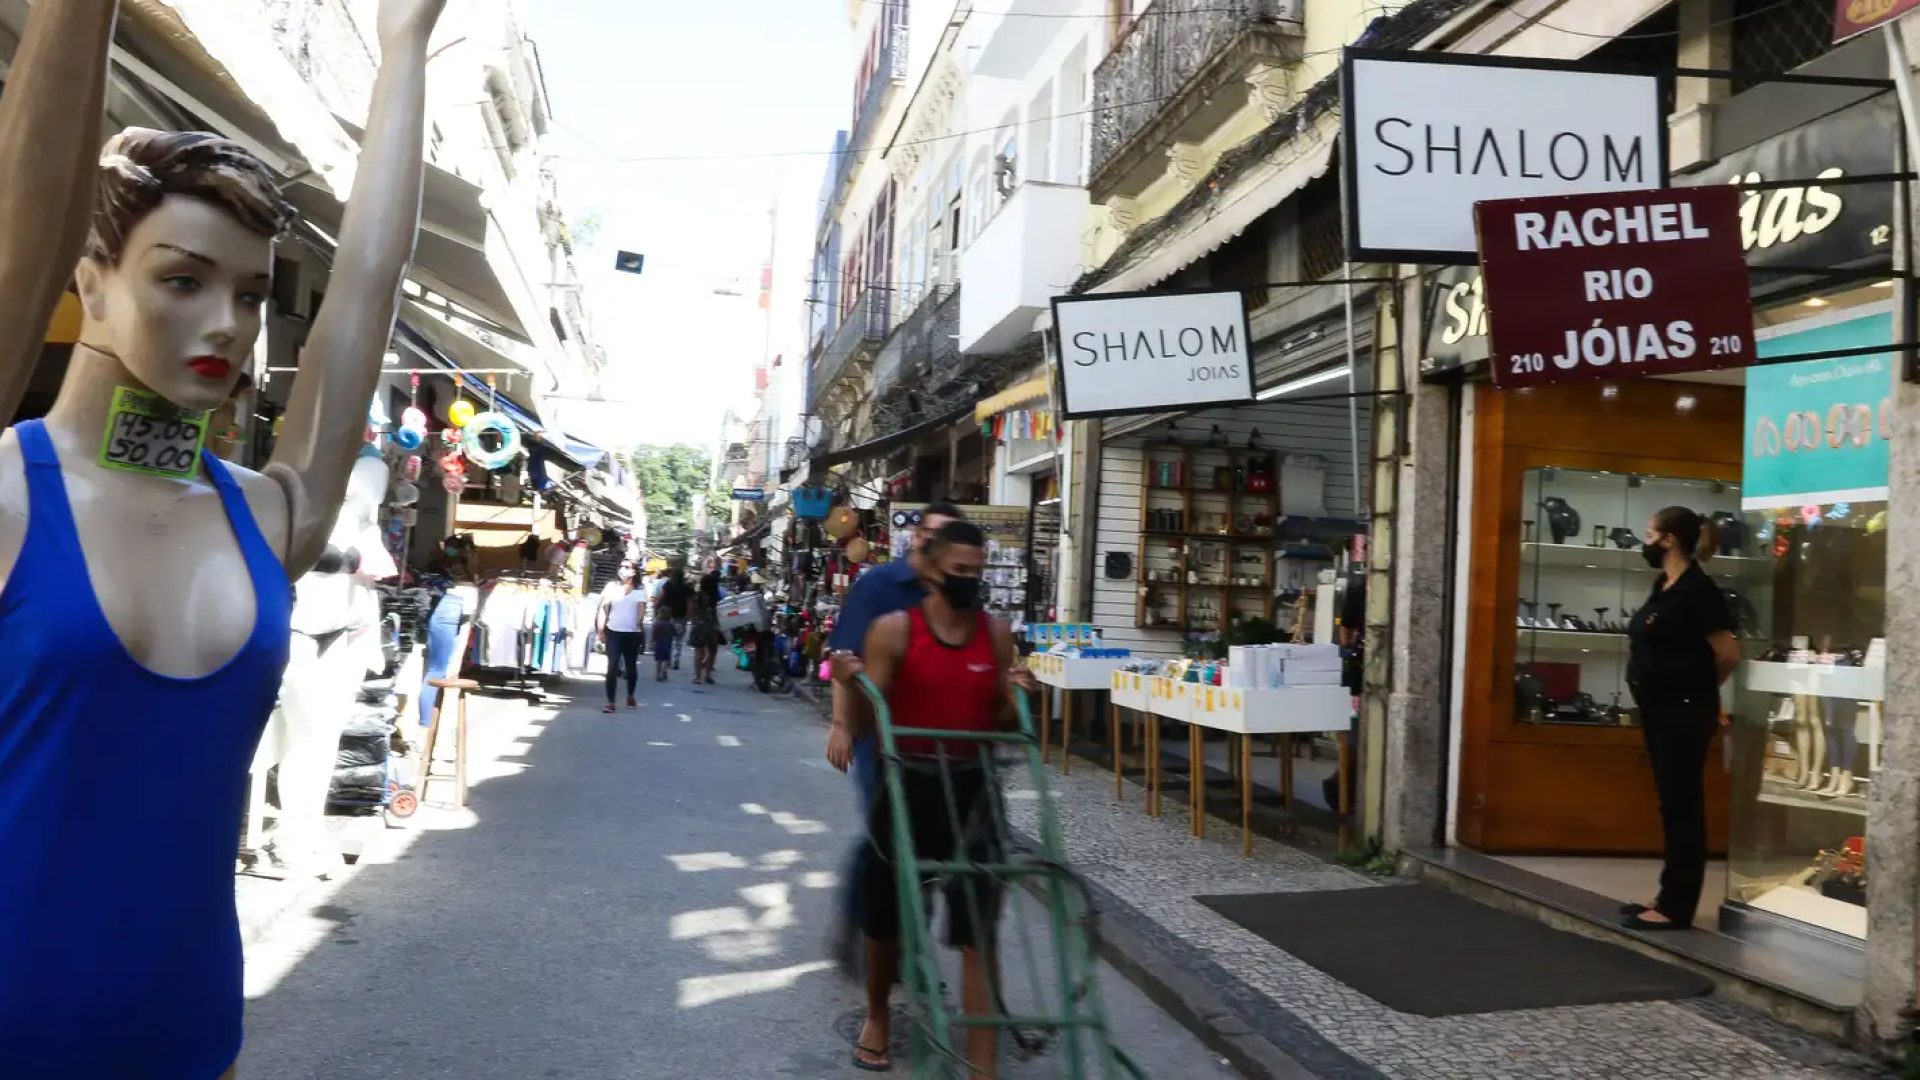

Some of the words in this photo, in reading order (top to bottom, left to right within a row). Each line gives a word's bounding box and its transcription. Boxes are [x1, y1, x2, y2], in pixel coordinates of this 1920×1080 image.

[1374, 117, 1643, 183] SHALOM
[1514, 203, 1709, 250] RACHEL
[1583, 267, 1653, 302] RIO
[1073, 324, 1238, 367] SHALOM
[1510, 352, 1544, 374] 210
[1552, 318, 1697, 369] JÓIAS
[1709, 335, 1743, 356] 210
[1187, 364, 1241, 382] JOIAS
[105, 437, 196, 470] 50.00
